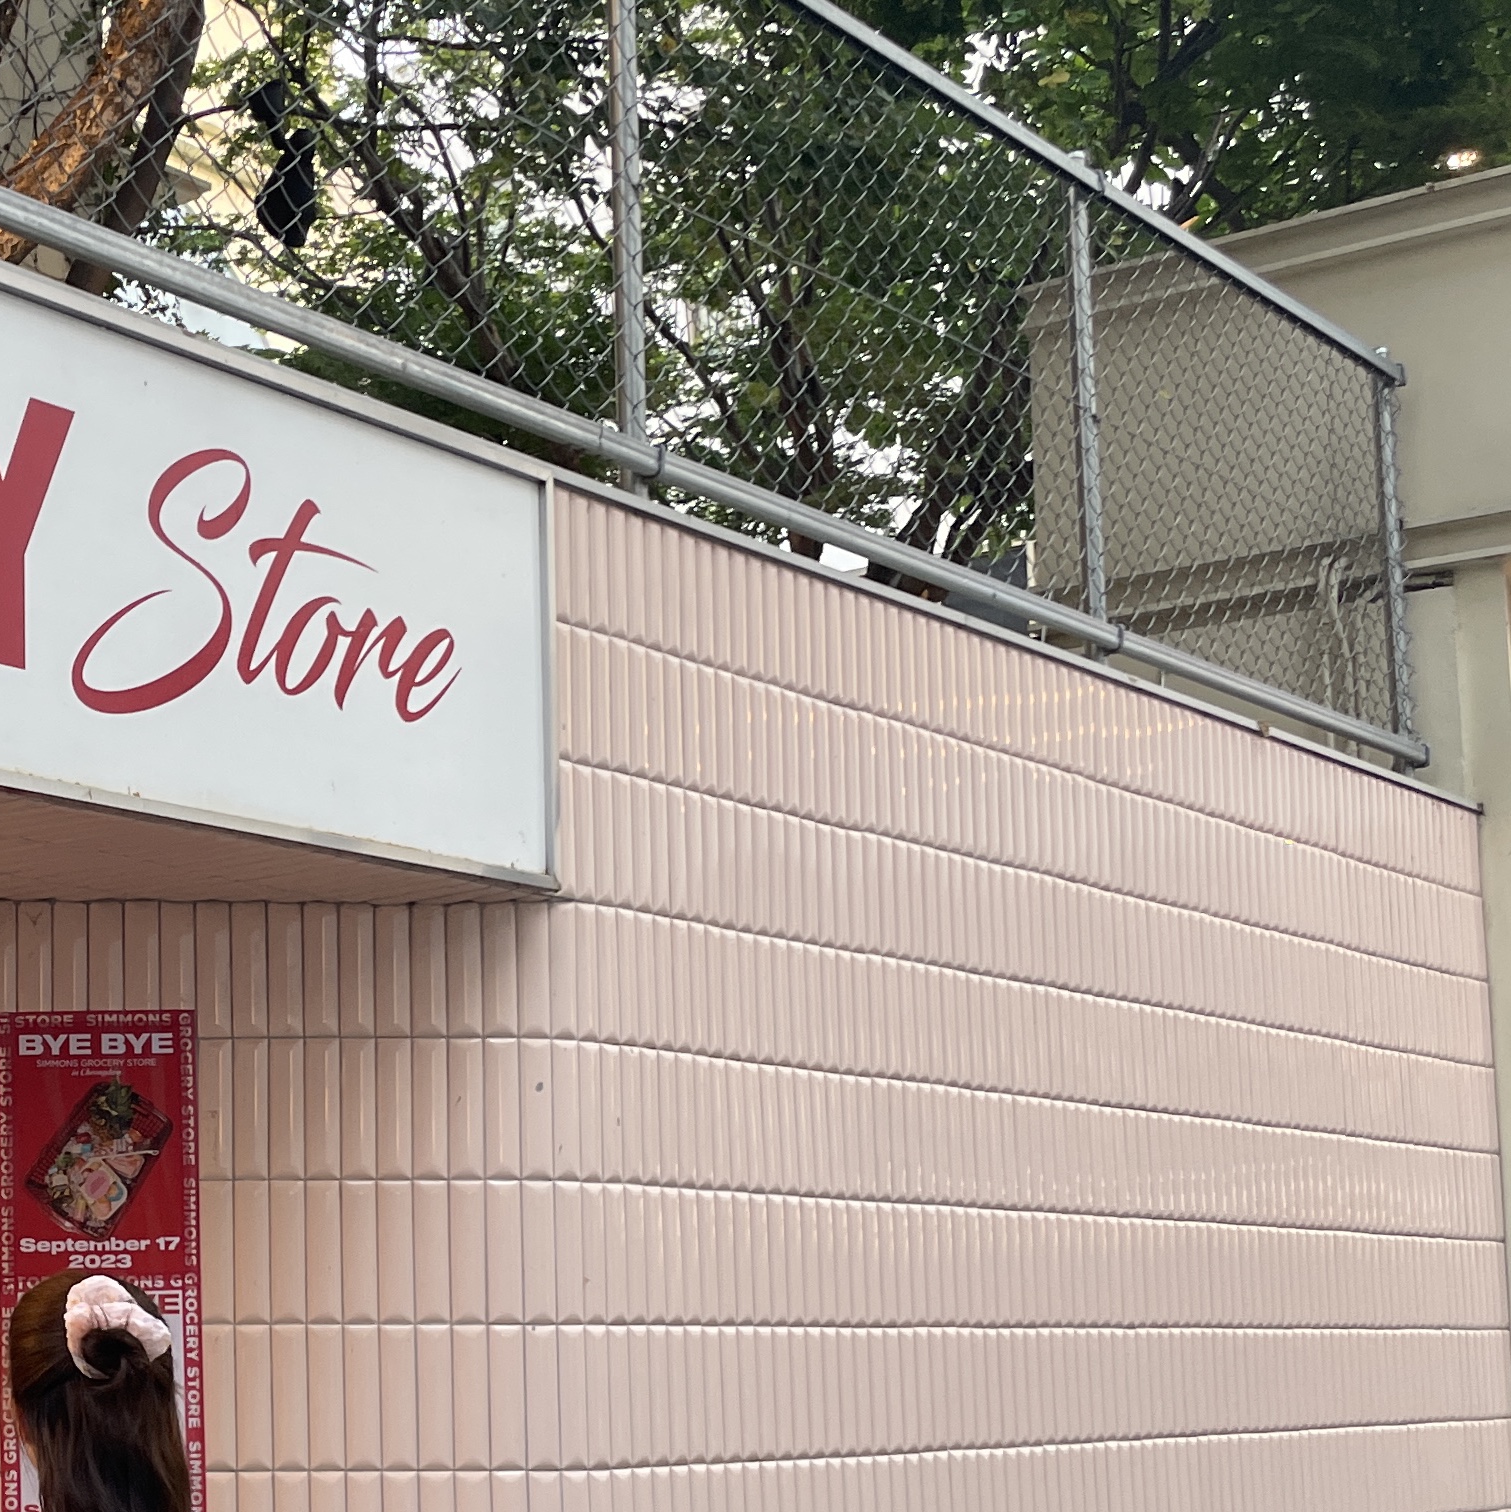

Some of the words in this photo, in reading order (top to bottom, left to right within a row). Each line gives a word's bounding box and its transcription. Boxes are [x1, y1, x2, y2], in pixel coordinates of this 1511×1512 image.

[73, 449, 459, 722] Store
[15, 1015, 74, 1028] STORE
[86, 1013, 171, 1028] SIMMONS
[19, 1034, 92, 1056] BYE
[101, 1032, 174, 1055] BYE
[0, 1047, 12, 1106] STORE
[36, 1059, 79, 1068] SIMMONS
[80, 1058, 124, 1067] GROCERY
[127, 1057, 157, 1067] STORE
[179, 1013, 194, 1100] GROCERY
[0, 1112, 14, 1199] GROCERY
[182, 1105, 195, 1165] STORE
[1, 1206, 15, 1295] SIMMONS
[19, 1237, 150, 1255] September
[155, 1236, 180, 1252] 17
[183, 1178, 197, 1266] SIMMONS
[68, 1254, 132, 1269] 2023
[185, 1272, 199, 1361] GROCERY
[187, 1366, 201, 1429] STORE
